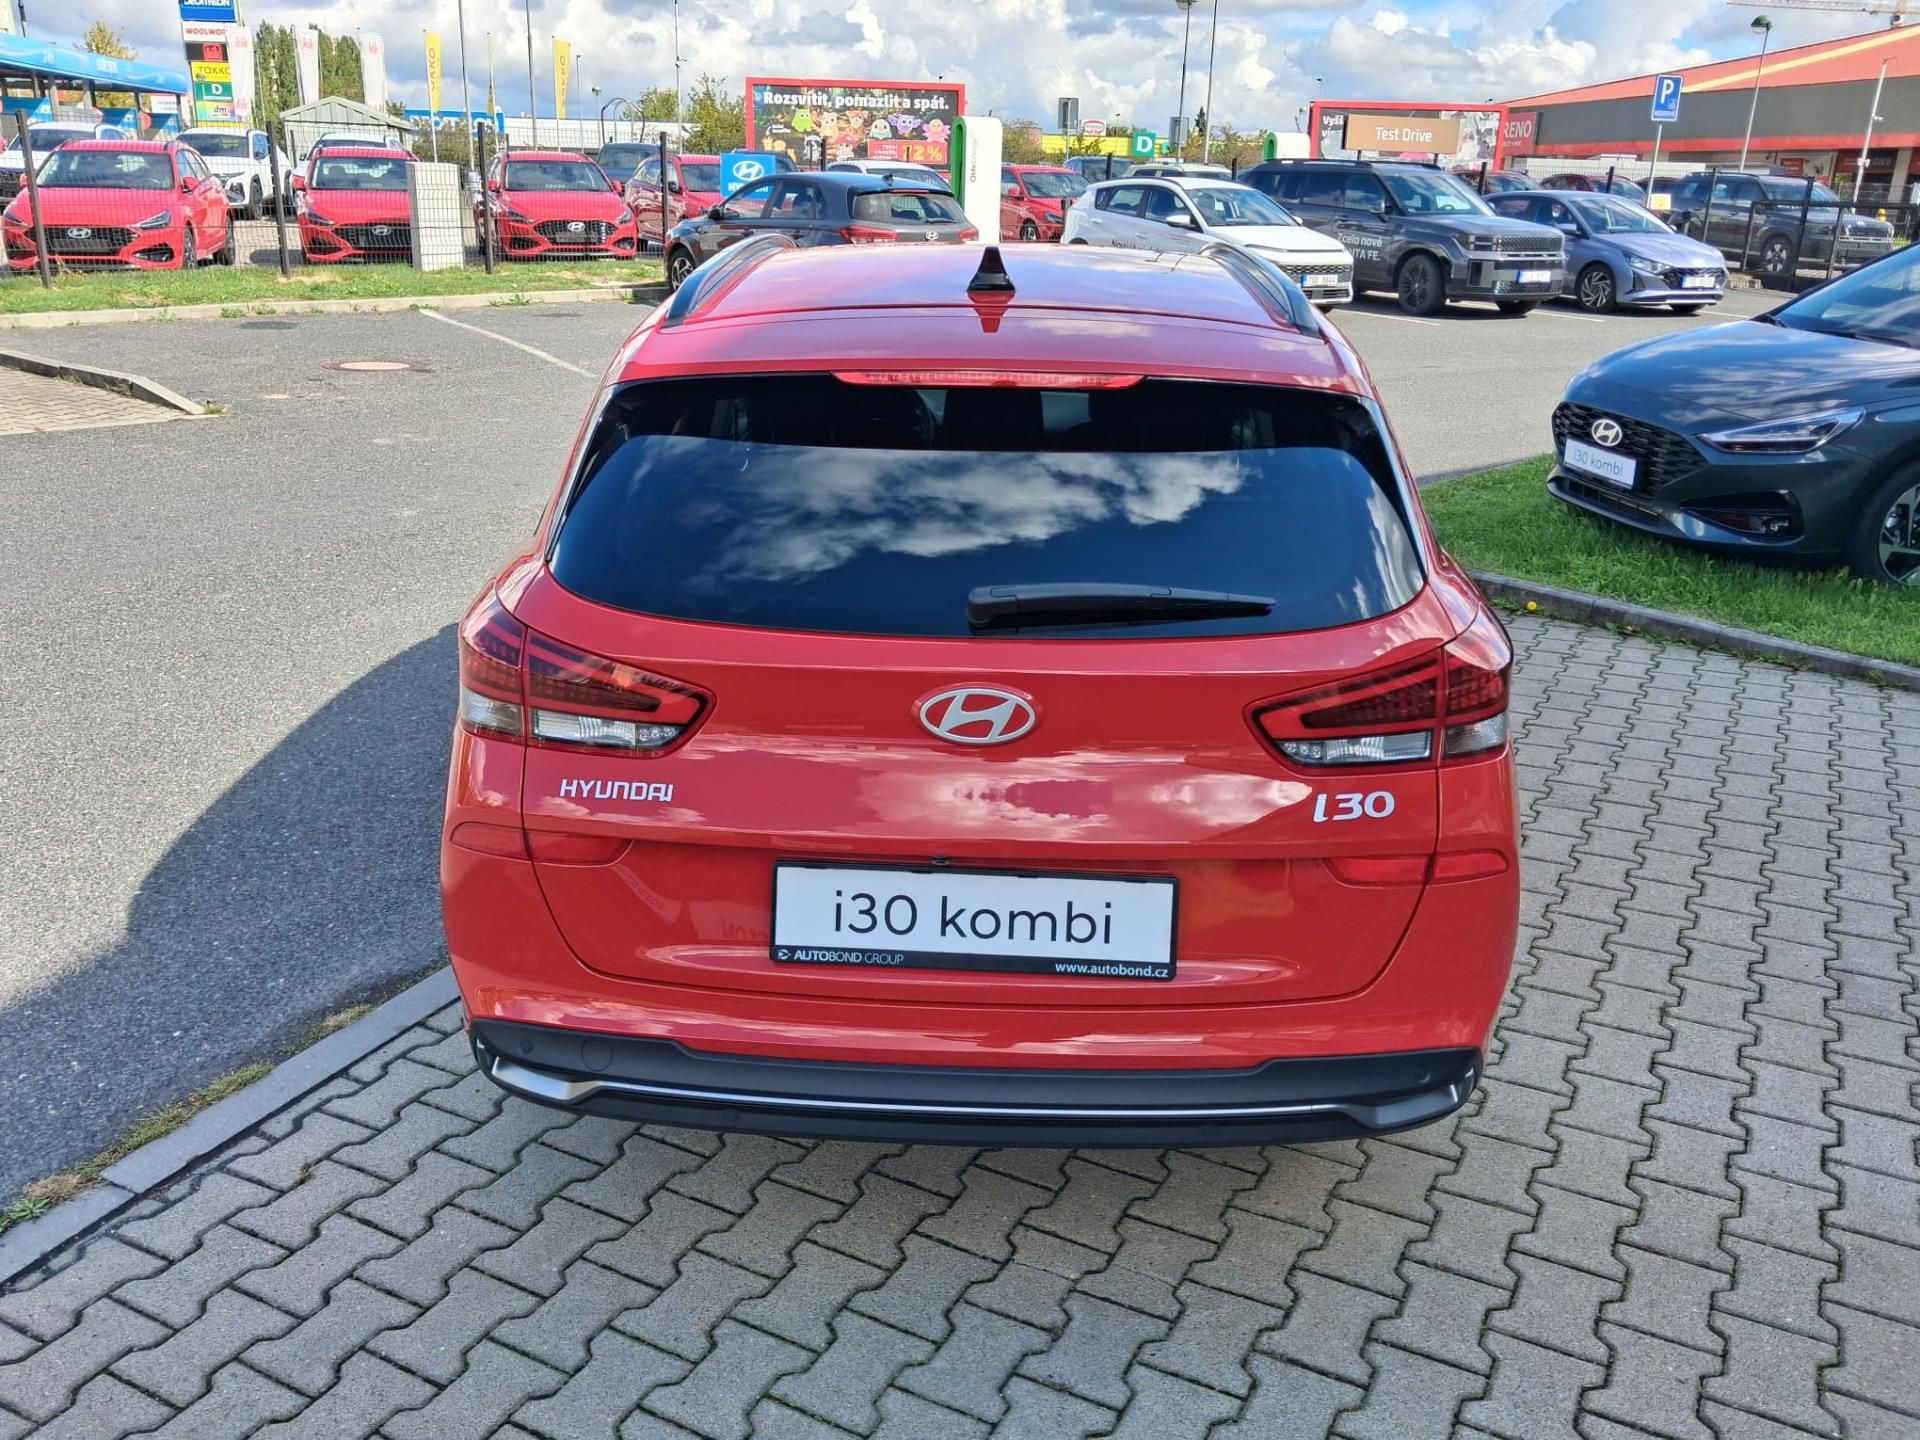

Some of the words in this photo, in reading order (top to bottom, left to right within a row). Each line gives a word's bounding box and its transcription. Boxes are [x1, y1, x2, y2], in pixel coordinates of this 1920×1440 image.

[185, 28, 226, 36] WOOLWOR
[212, 84, 223, 95] D
[1660, 79, 1674, 104] P
[835, 94, 899, 109] pomazlit
[902, 98, 911, 109] a
[913, 95, 949, 112] spát.
[1322, 114, 1344, 127] Vyšš
[1375, 127, 1399, 141] Test
[1402, 129, 1433, 142] Drive
[1137, 136, 1153, 153] D
[1361, 236, 1383, 248] nové
[1574, 449, 1589, 465] i30
[1590, 452, 1624, 477] kombi
[560, 779, 674, 802] HYUNDAI
[1313, 790, 1395, 823] i30
[834, 890, 918, 936] i30
[940, 896, 1112, 945] kombi
[794, 950, 862, 963] AUTOBOND
[864, 952, 905, 965] GROUP
[1055, 963, 1169, 978] www.autobond.cz
